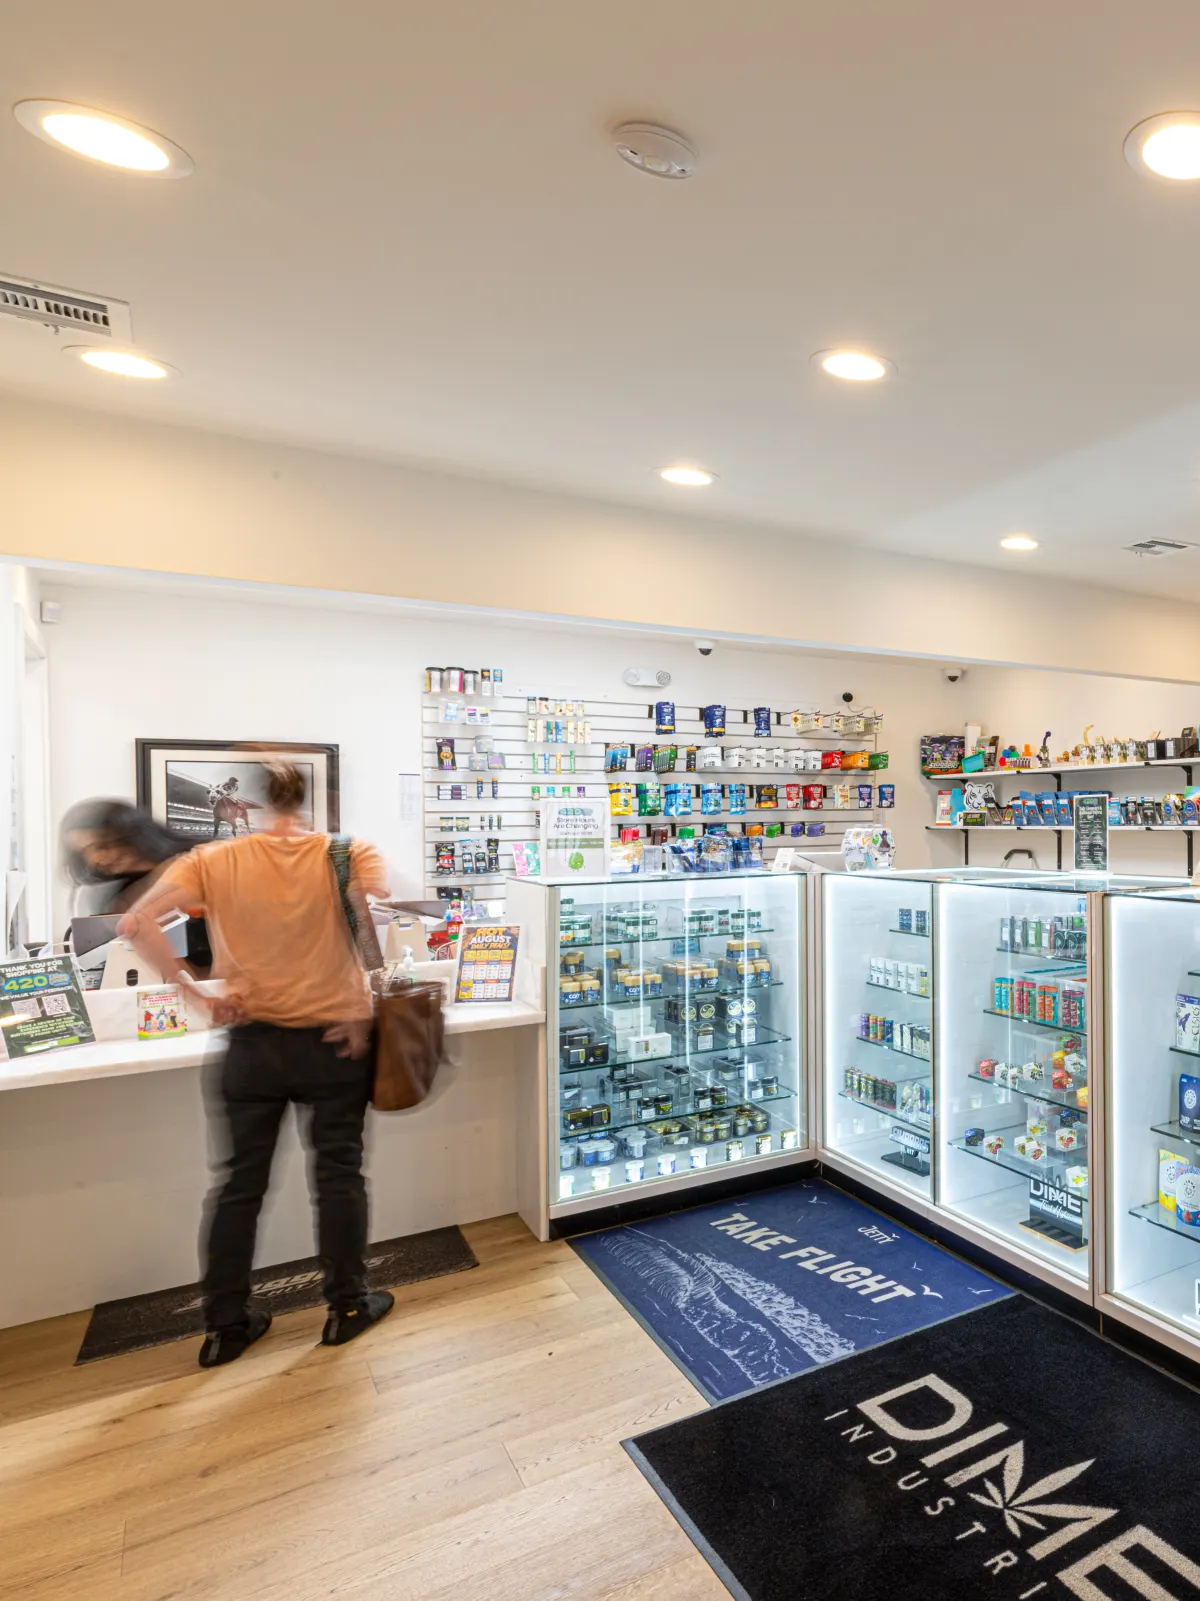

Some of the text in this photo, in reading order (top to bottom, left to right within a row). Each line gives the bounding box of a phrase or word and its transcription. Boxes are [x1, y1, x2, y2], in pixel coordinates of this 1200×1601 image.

[476, 927, 507, 936] HOT
[469, 935, 512, 945] AUGUST
[0, 959, 63, 974] THANK YOU FOR
[5, 968, 46, 978] SHOPPING
[4, 975, 48, 991] 420
[857, 1224, 900, 1245] JETTY
[709, 1212, 918, 1305] TAKE FLIGHT
